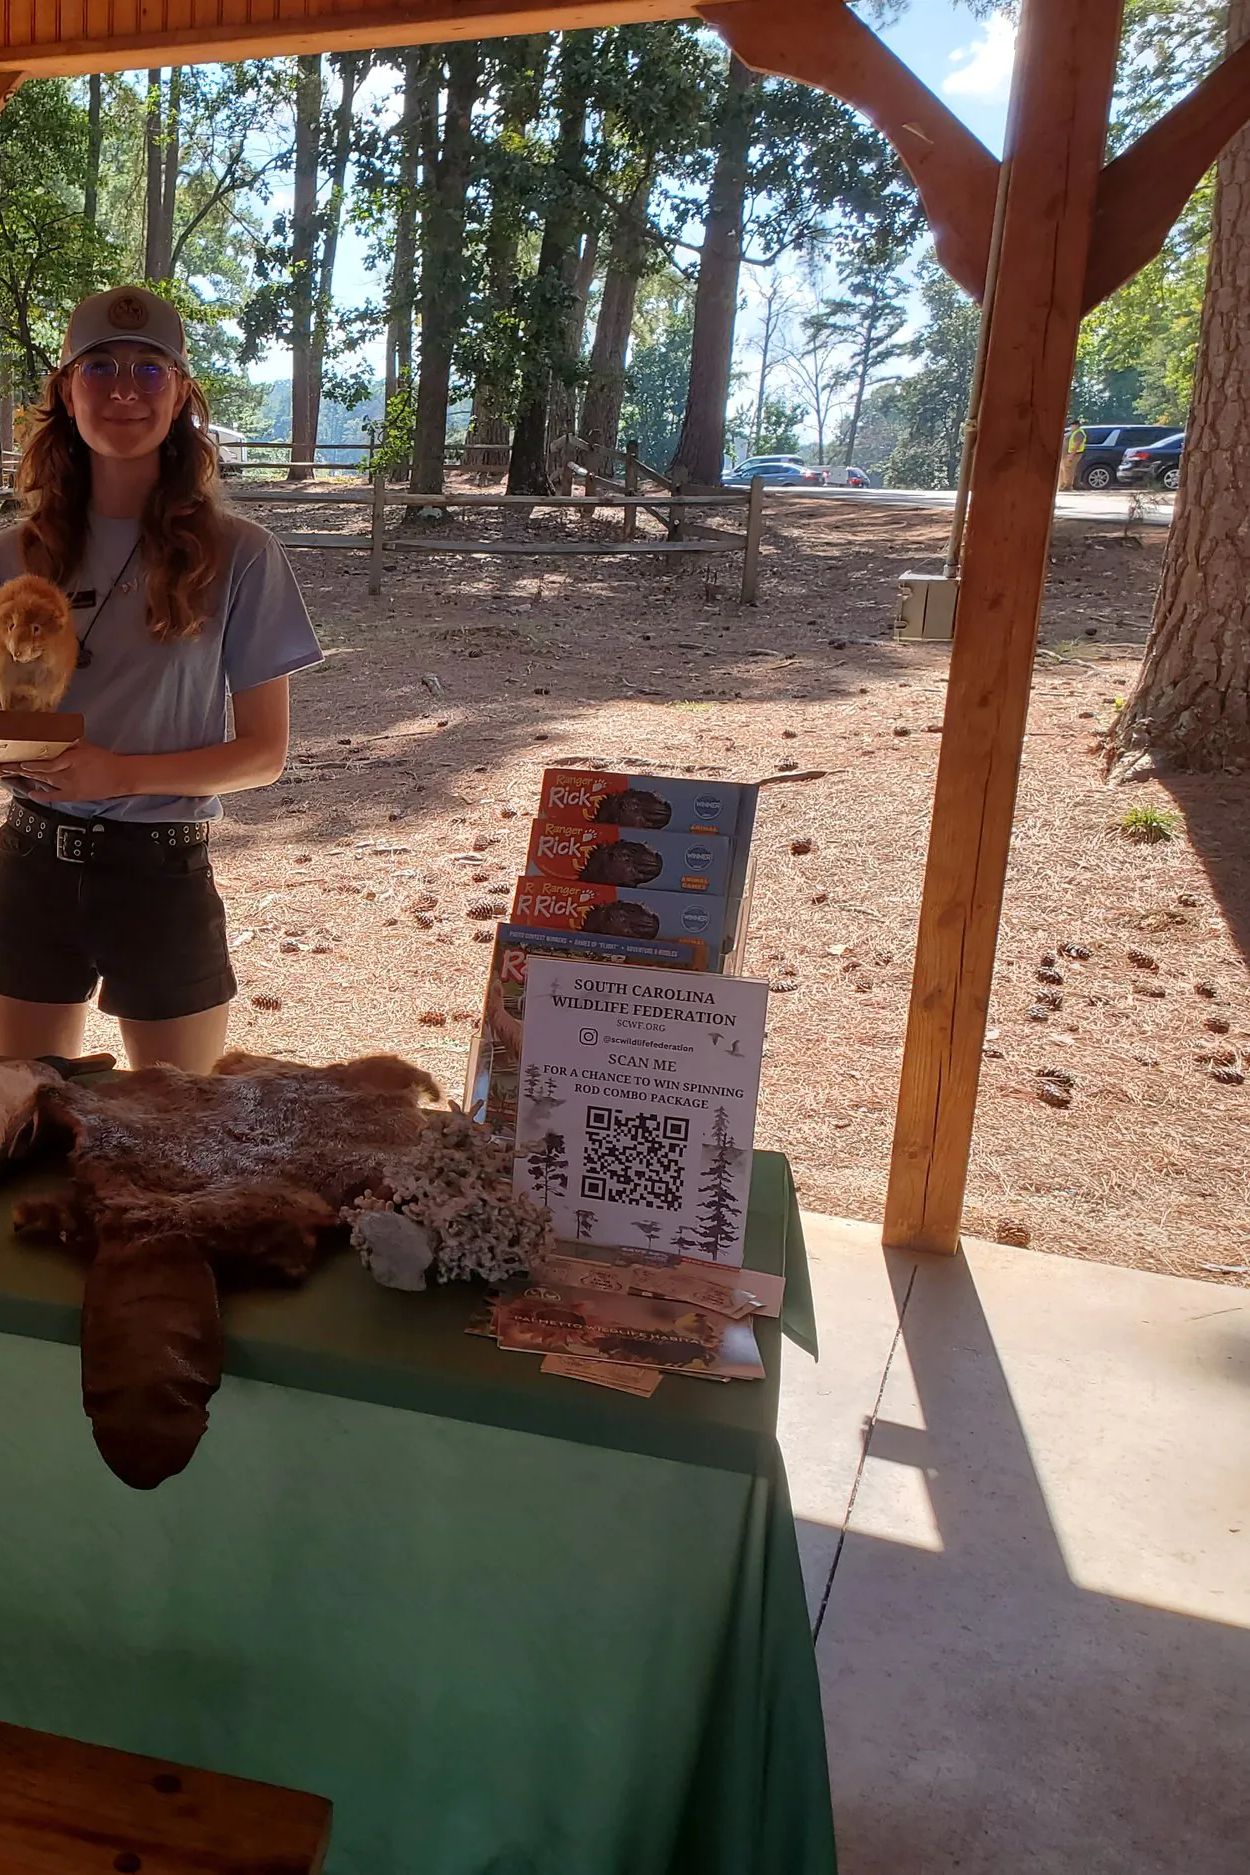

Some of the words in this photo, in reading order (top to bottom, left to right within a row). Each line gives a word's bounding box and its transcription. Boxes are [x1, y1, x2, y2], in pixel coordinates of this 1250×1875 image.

[556, 774, 594, 787] Ranger
[549, 786, 591, 809] Rick
[545, 823, 583, 837] Ranger
[537, 836, 580, 859] Rick
[542, 883, 581, 896] Ranger
[534, 895, 578, 918] Rick
[574, 978, 628, 996] SOUTH
[632, 985, 715, 1005] CAROLINA
[552, 995, 629, 1015] WILDLIFE
[632, 1004, 737, 1027] FEDERATION
[617, 1019, 666, 1032] SCWF.ORG
[603, 1035, 694, 1053] @scwildlifefederation
[608, 1053, 651, 1070] SCAN
[653, 1058, 677, 1073] ME
[543, 1064, 568, 1077] FOR
[569, 1067, 579, 1078] A
[581, 1069, 632, 1086] CHANCE
[634, 1076, 651, 1088] TO
[654, 1078, 680, 1091] WIN
[682, 1081, 744, 1099] SPINNING
[574, 1083, 600, 1096] ROD
[603, 1086, 648, 1102] COMBO
[650, 1092, 709, 1110] PACKAGE
[586, 1325, 648, 1339] WILDLIFE
